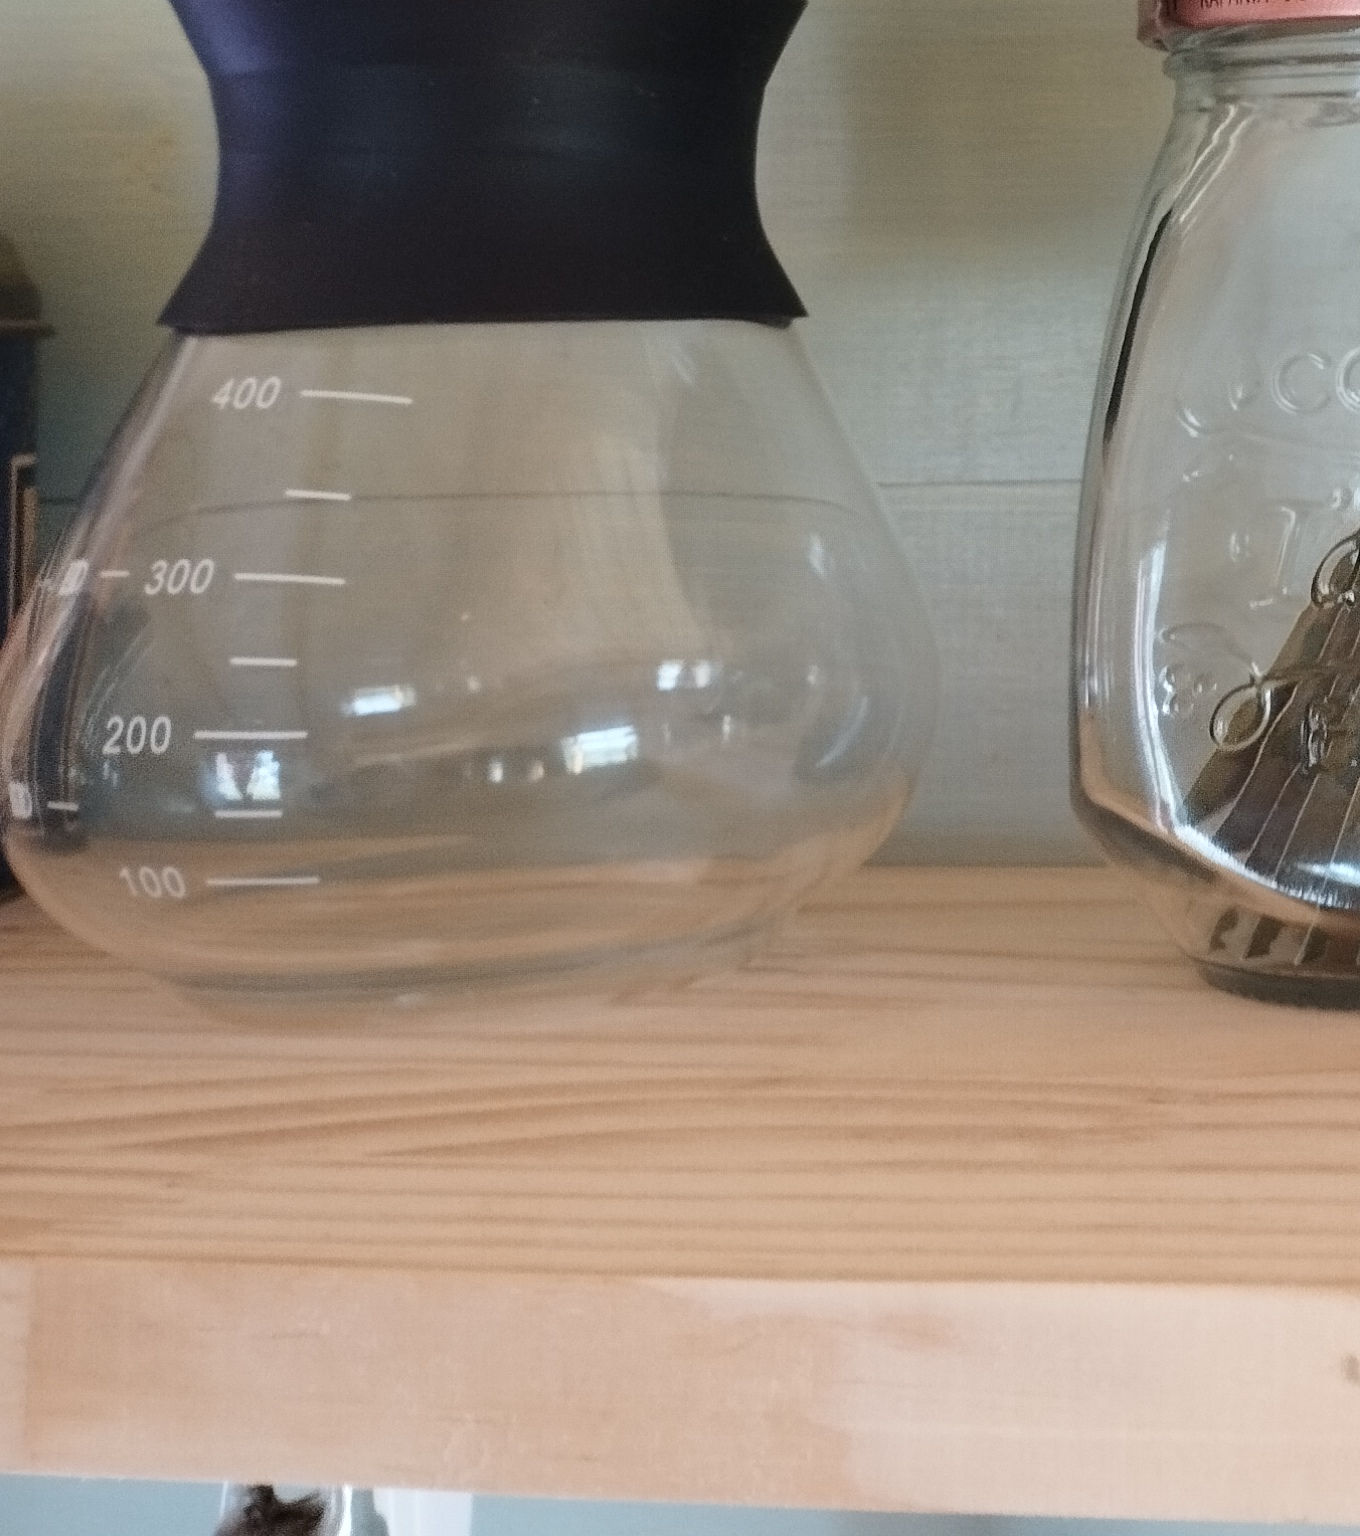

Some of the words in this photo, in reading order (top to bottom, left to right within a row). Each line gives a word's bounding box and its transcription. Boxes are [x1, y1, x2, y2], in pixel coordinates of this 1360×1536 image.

[212, 375, 282, 410] 400
[144, 559, 215, 596] 300
[101, 715, 172, 756] 200
[118, 865, 187, 900] 100
